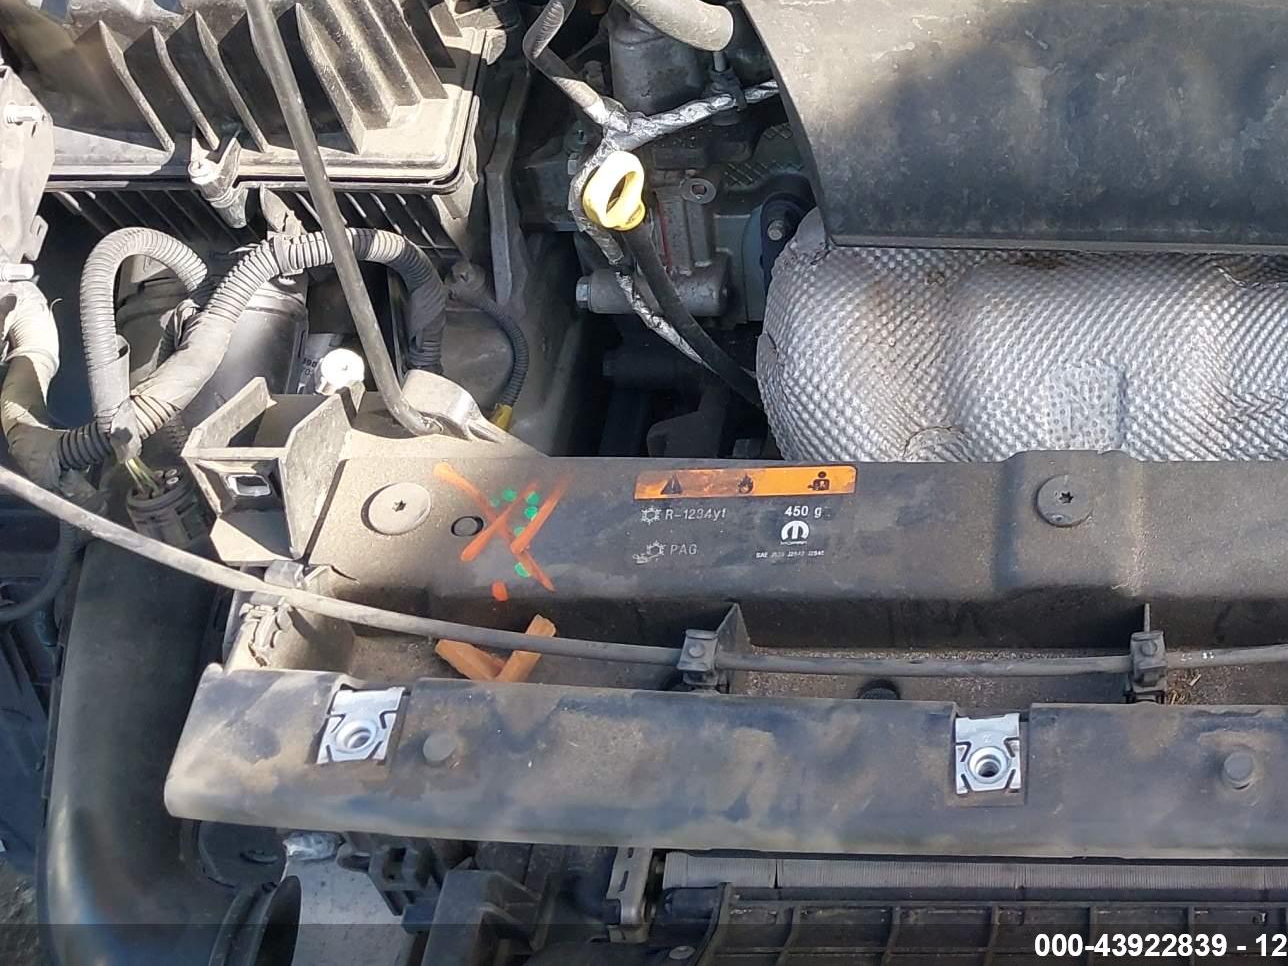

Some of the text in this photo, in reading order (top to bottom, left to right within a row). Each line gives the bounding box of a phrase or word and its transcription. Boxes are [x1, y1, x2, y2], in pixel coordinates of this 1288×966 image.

[784, 505, 822, 518] 450 g
[669, 544, 698, 555] PAG
